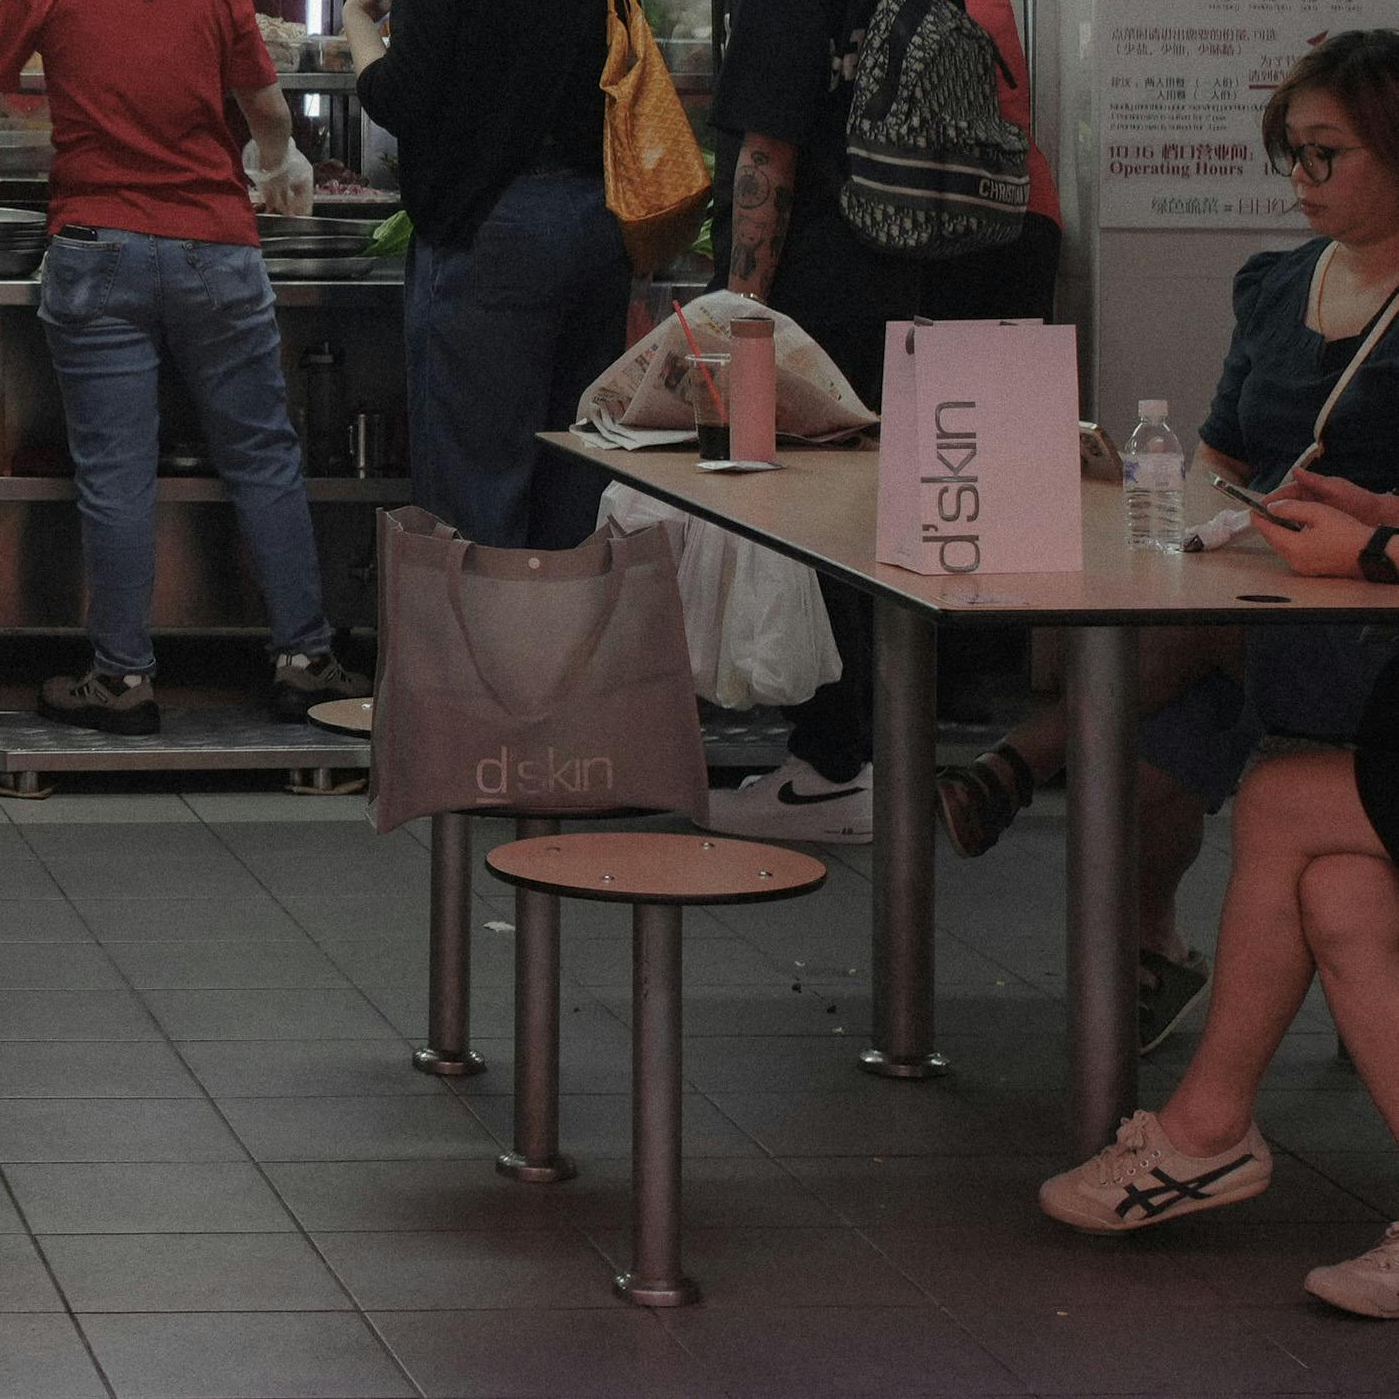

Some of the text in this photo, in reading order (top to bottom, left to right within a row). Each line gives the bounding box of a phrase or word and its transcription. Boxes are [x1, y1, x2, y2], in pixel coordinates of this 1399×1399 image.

[1109, 160, 1191, 179] Operating
[1195, 161, 1244, 176] Hours
[920, 401, 981, 573] d'skin
